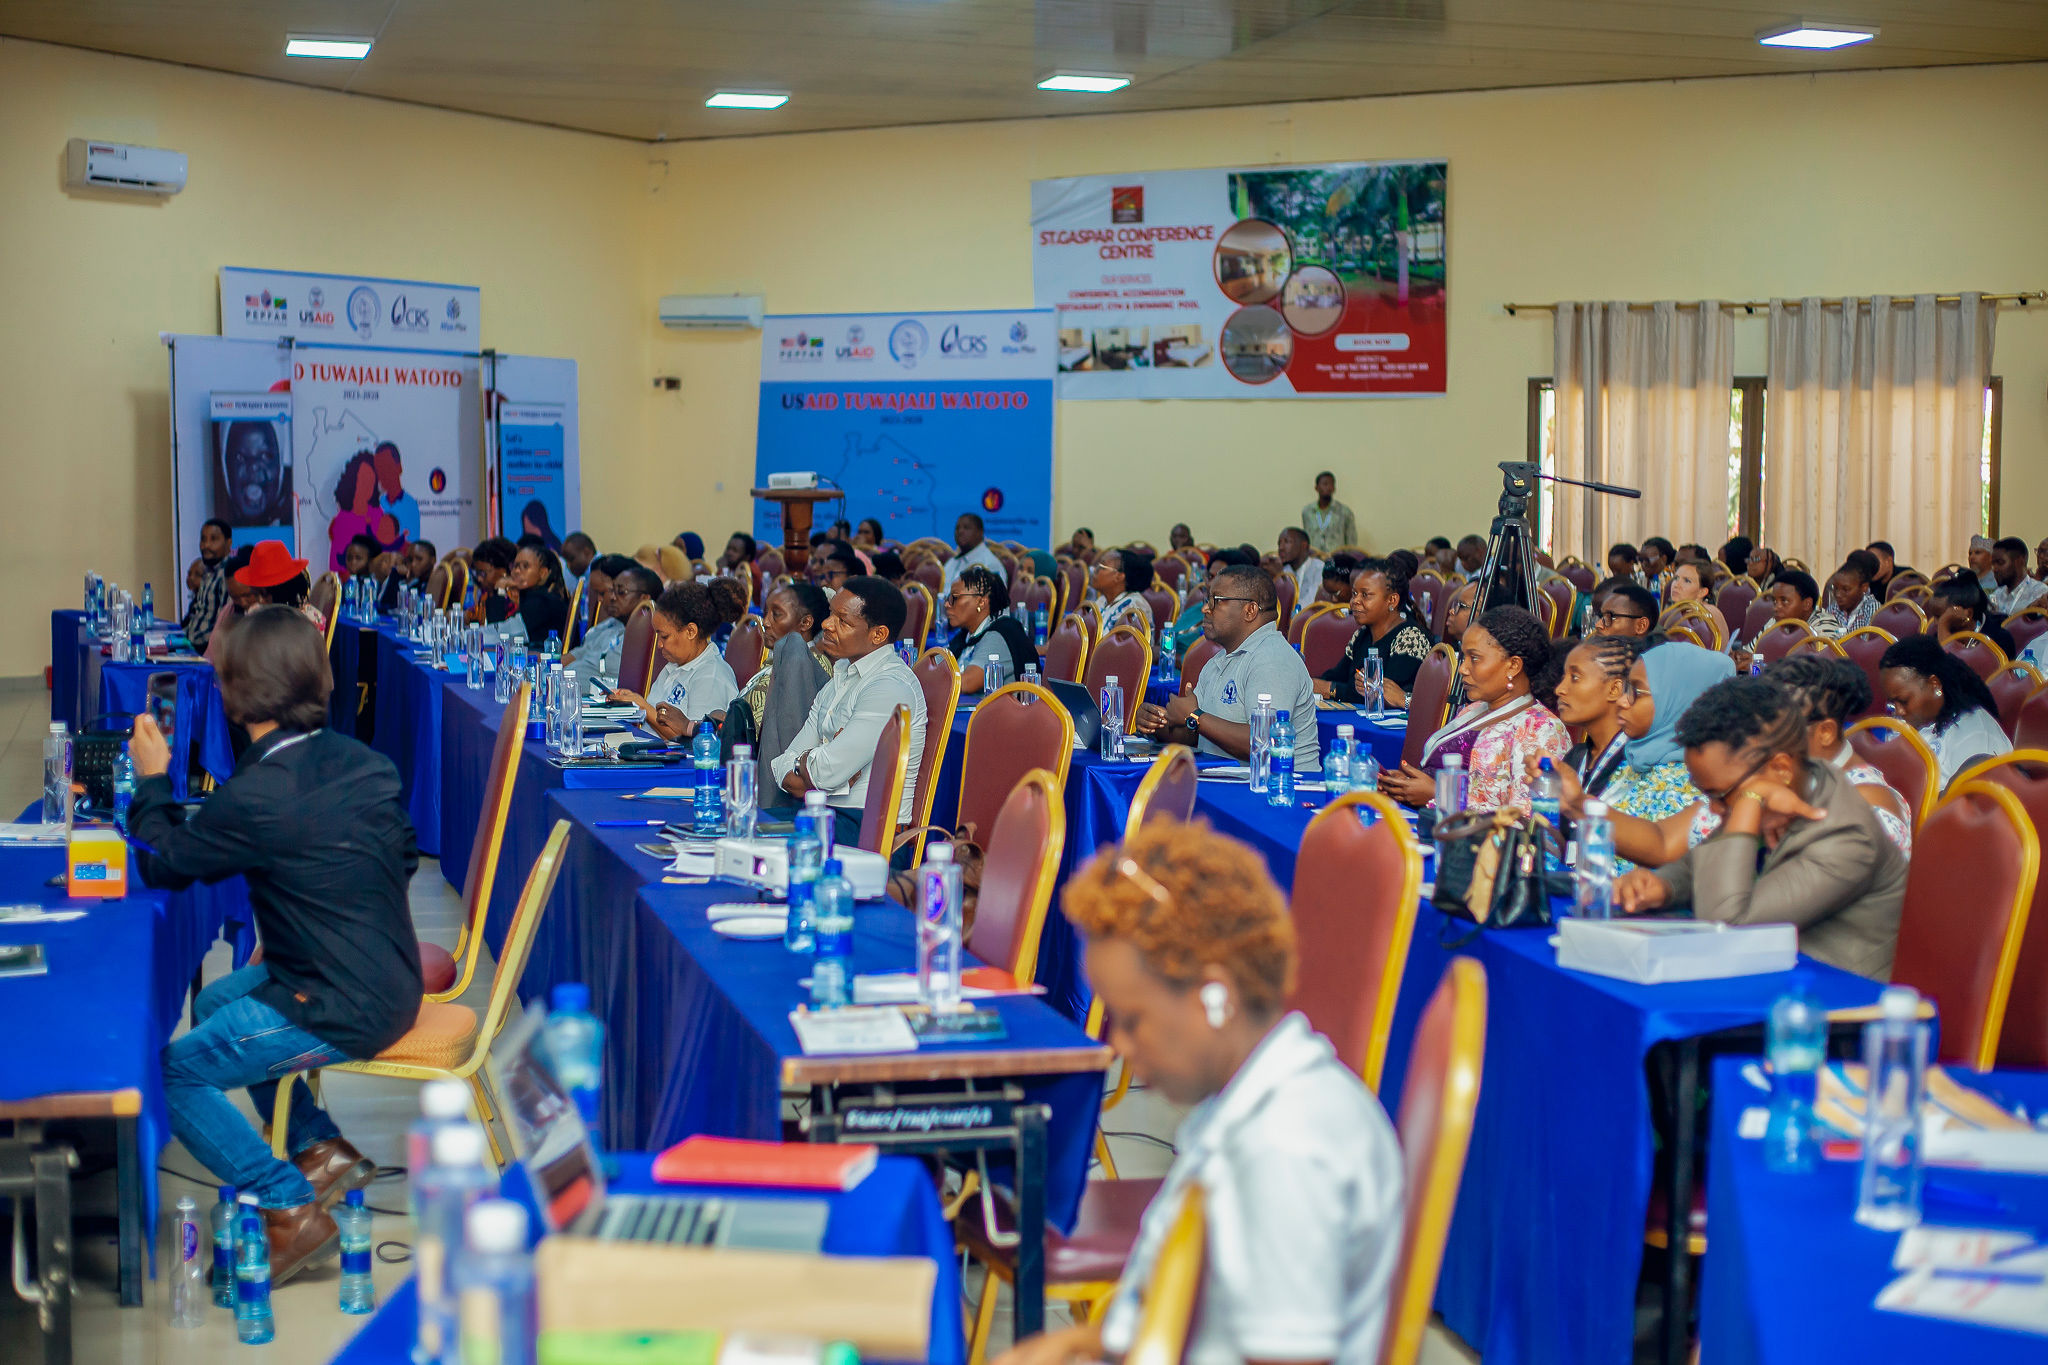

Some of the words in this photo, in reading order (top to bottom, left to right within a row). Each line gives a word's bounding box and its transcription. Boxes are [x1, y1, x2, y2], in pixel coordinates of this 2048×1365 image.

[1039, 229, 1115, 245] ST.GASPAR
[1118, 226, 1214, 242] CONFERENCE
[1099, 244, 1155, 259] CENTRE
[300, 311, 334, 325] USAID
[406, 307, 429, 327] CRS
[961, 334, 988, 352] CRS
[835, 346, 875, 360] USAID
[310, 363, 389, 386] TUWAJALI
[395, 368, 462, 388] WATOTO
[782, 392, 838, 410] USAID
[843, 391, 936, 413] TUWAJALI
[940, 391, 1029, 410] WATOTO
